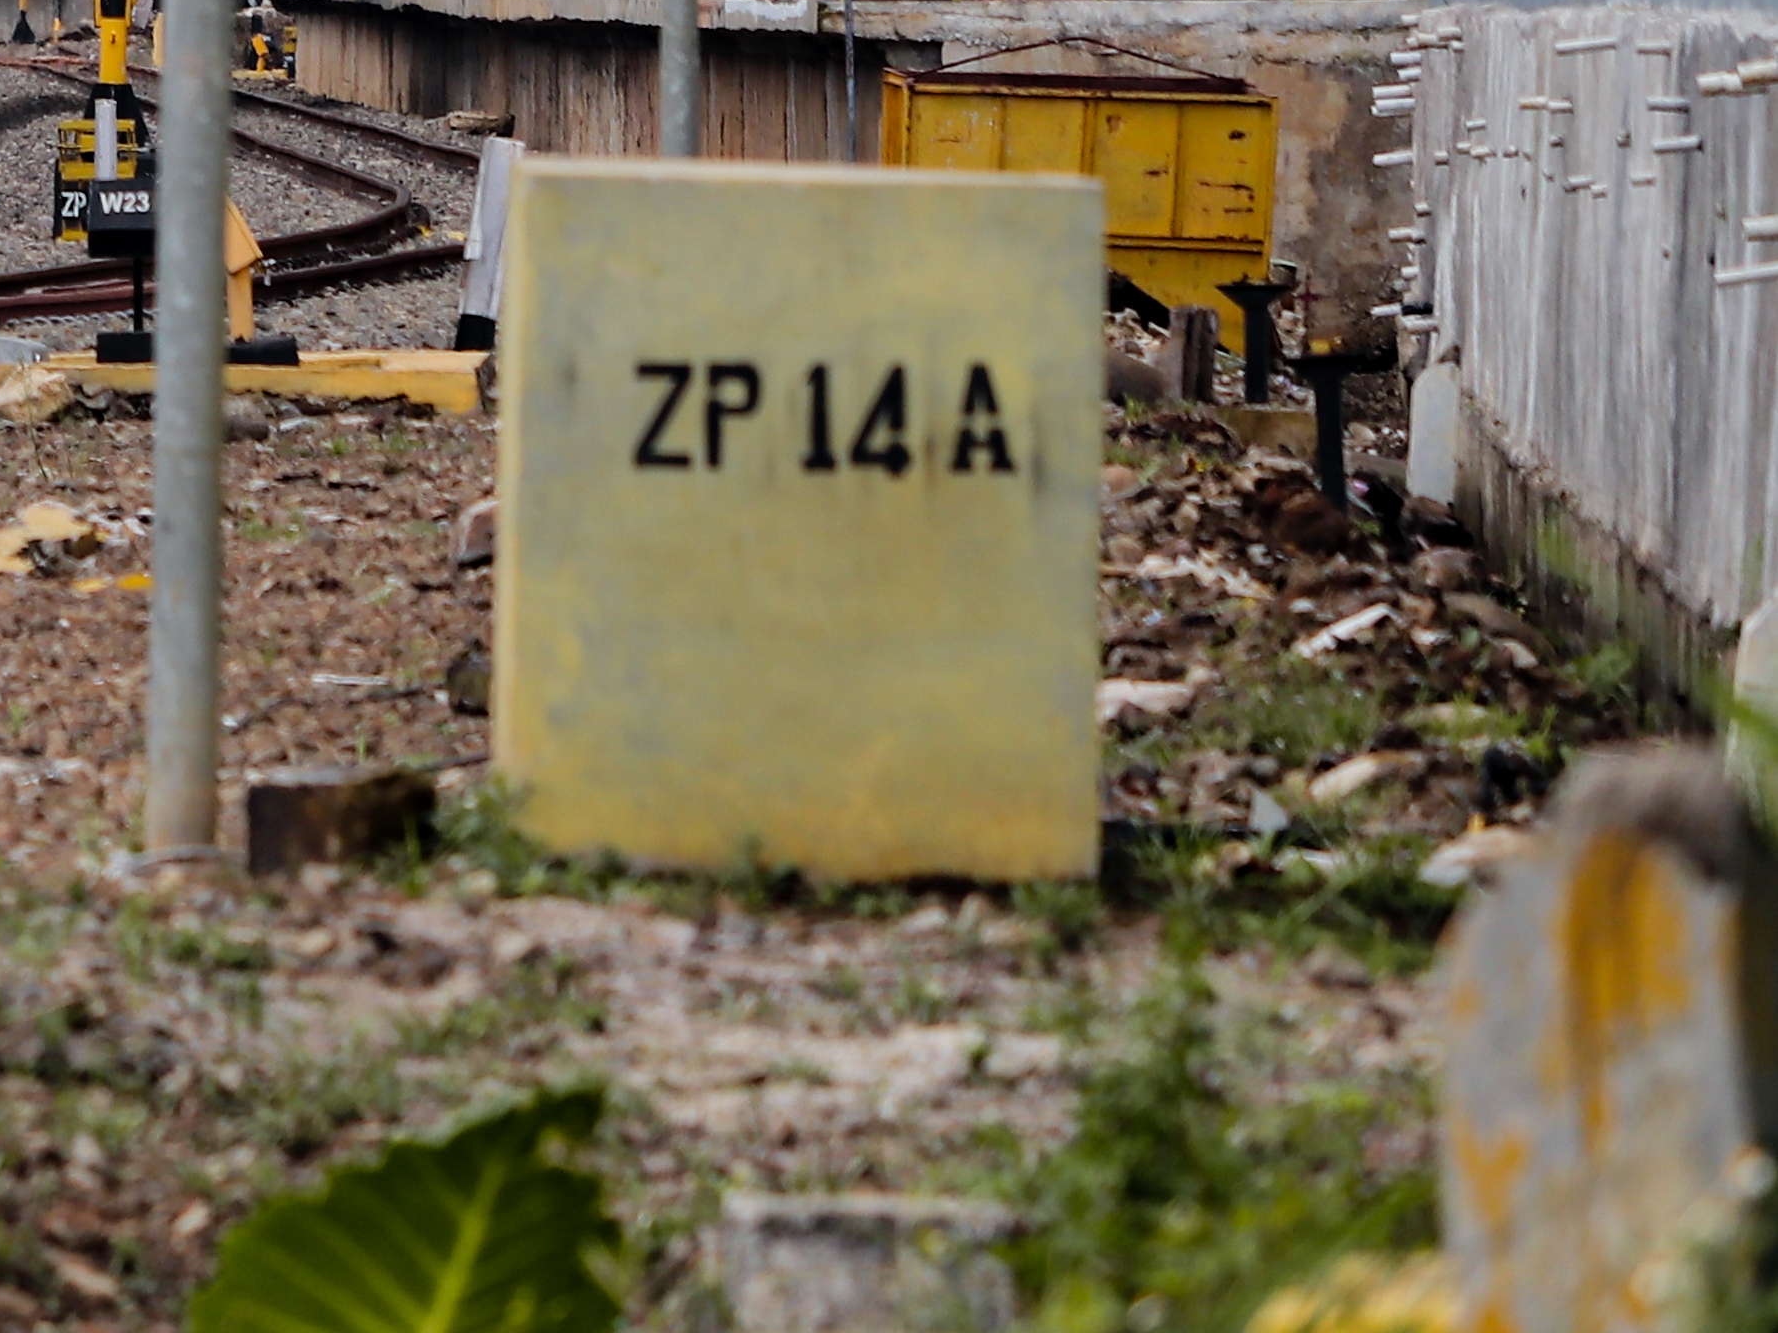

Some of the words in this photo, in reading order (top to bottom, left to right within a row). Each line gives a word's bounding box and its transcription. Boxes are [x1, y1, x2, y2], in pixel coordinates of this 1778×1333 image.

[98, 190, 151, 215] W23
[635, 362, 761, 471] ZP
[801, 362, 911, 476] 14
[950, 361, 1015, 472] A
